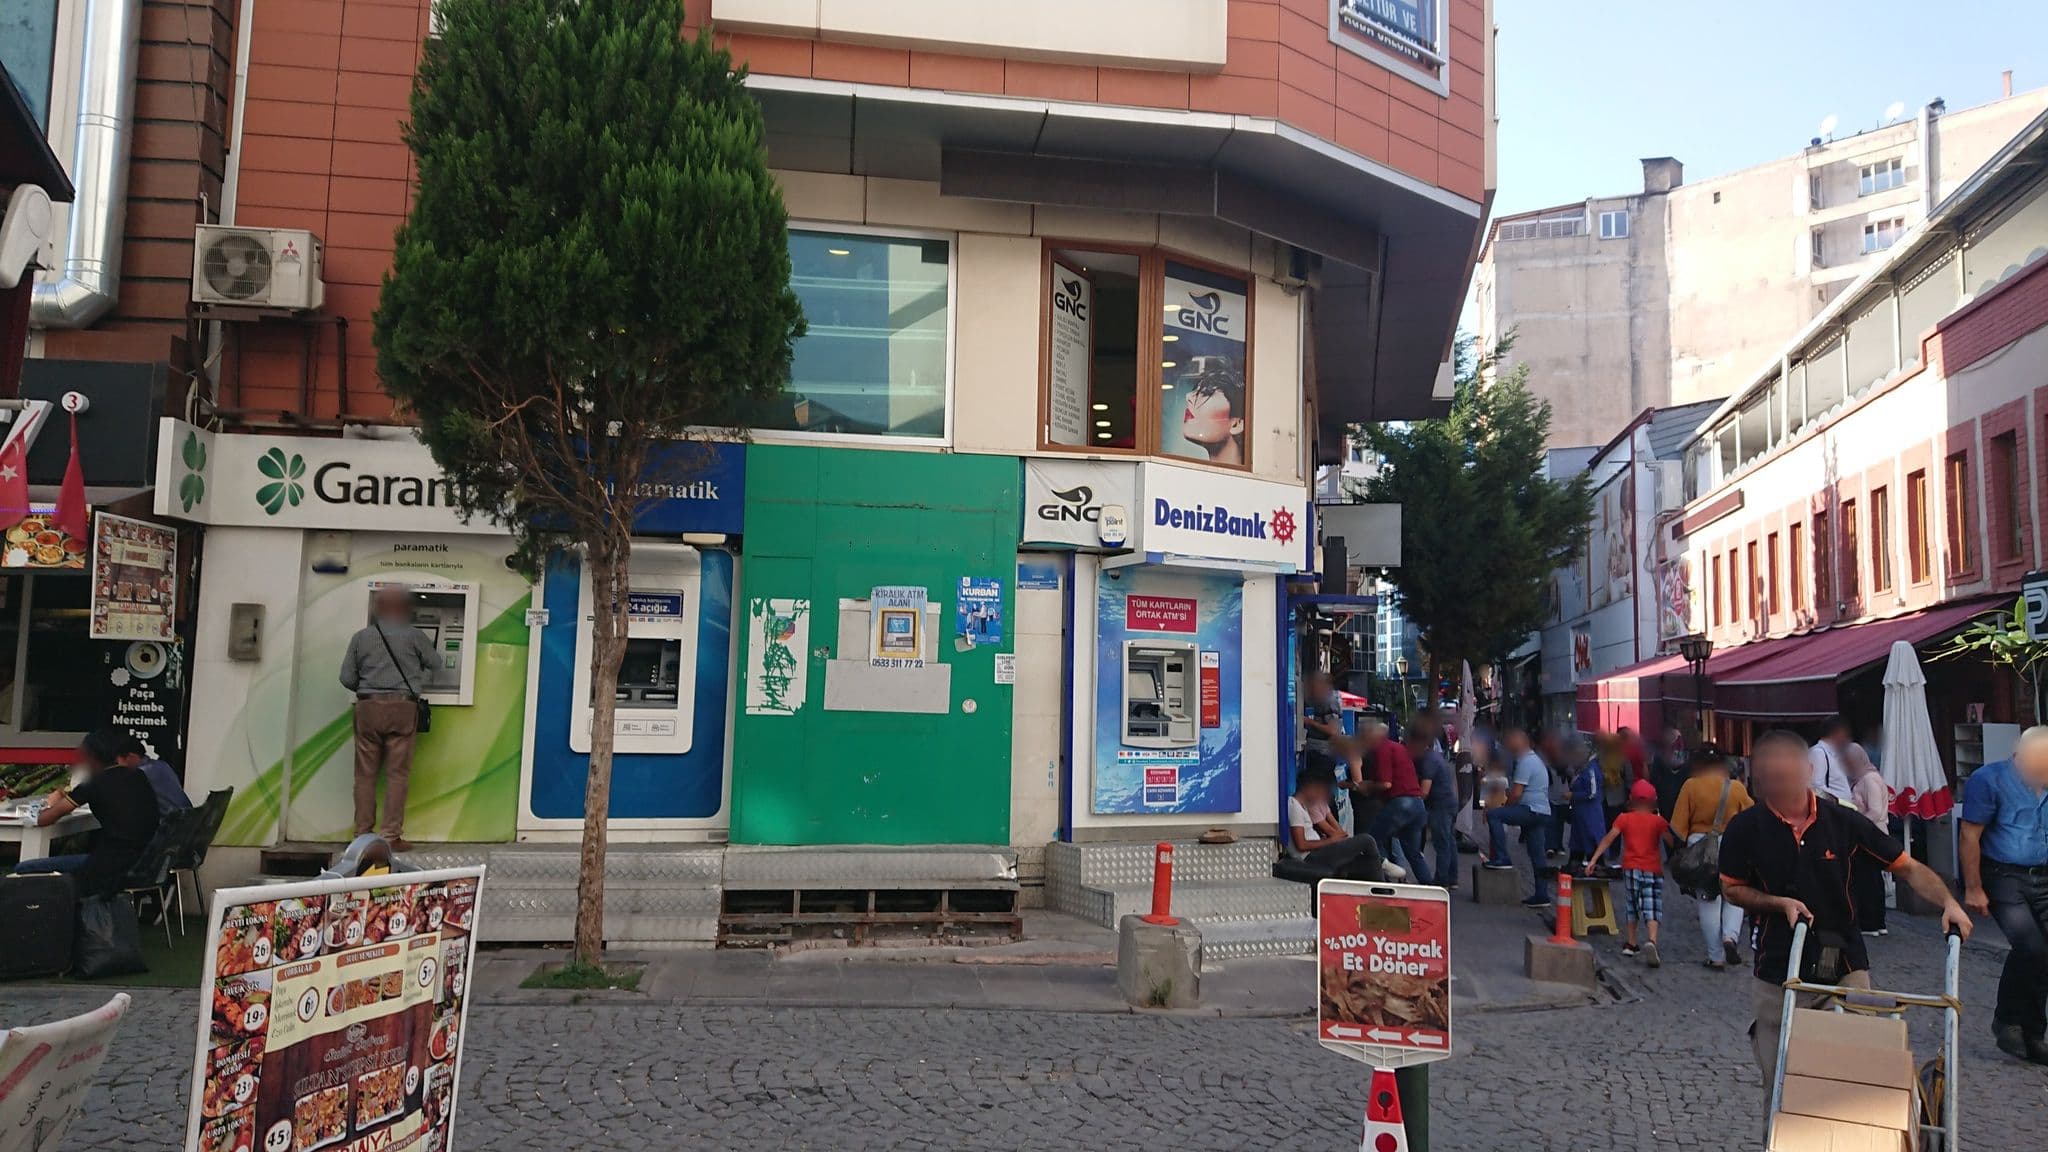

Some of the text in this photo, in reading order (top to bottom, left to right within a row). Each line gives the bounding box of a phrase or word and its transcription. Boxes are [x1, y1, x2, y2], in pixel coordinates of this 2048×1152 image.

[1054, 291, 1087, 322] GNC
[1178, 307, 1230, 336] GNC
[313, 461, 468, 508] Garan
[1037, 504, 1102, 523] GNC
[1154, 498, 1267, 540] DenizBank
[393, 543, 449, 553] paramatik
[907, 590, 924, 599] ATM
[962, 587, 998, 597] KURBAN
[640, 602, 671, 613] açığız.
[888, 598, 911, 607] ALANI
[1132, 599, 1191, 612] TÜM KARTLARIN
[1135, 610, 1161, 619] ORTAK
[872, 659, 924, 668] 0533 311 77 22
[129, 688, 155, 700] Paça
[118, 699, 165, 714] İşkembe
[112, 714, 168, 726] Mercimek
[1324, 933, 1443, 960] %100 Yaprak
[1342, 952, 1429, 977] Et Döner
